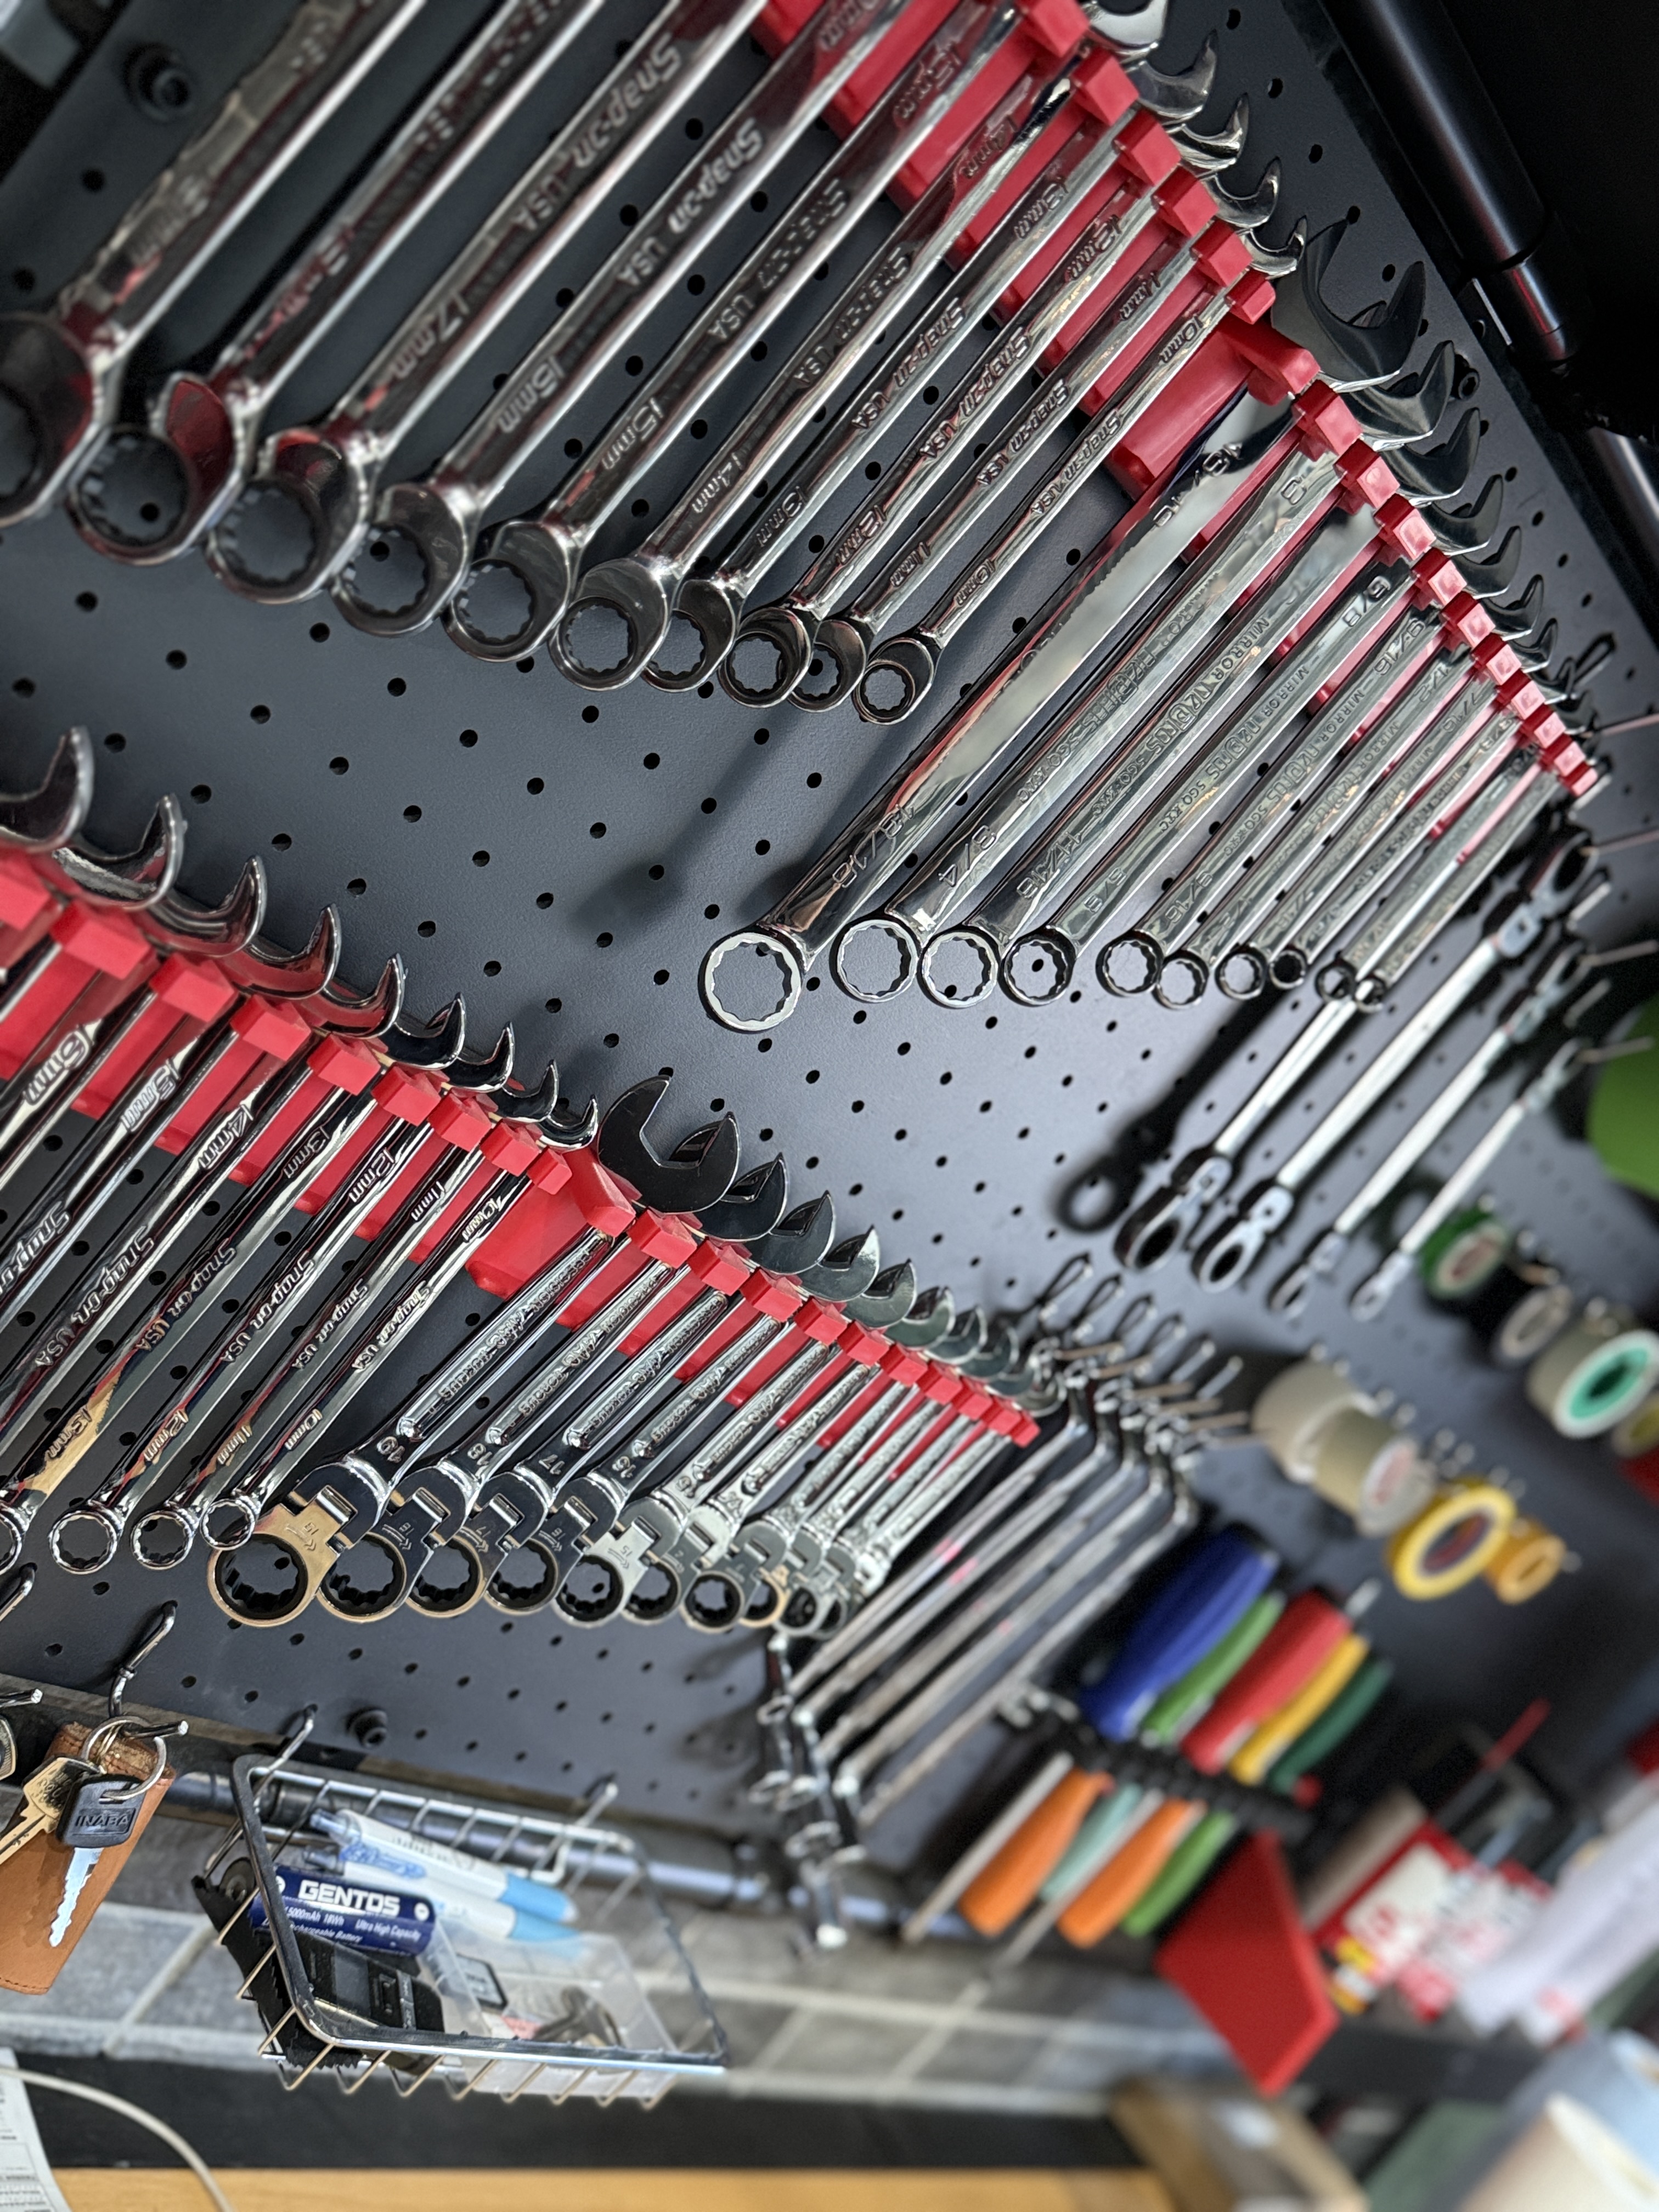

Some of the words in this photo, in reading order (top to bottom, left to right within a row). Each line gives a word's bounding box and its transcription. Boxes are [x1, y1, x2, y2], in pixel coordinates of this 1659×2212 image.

[560, 29, 691, 175] Snap-on
[508, 171, 570, 238] USA
[658, 113, 771, 240] Snap-on
[613, 233, 670, 292] USA
[383, 287, 475, 387] 17mm
[705, 290, 755, 345] USA
[885, 294, 971, 391] Snap-on
[1155, 313, 1205, 368] 10mm
[791, 343, 833, 388] USA
[948, 324, 1036, 422] Snap-on
[492, 353, 569, 439] 16mm
[849, 388, 891, 434] USA
[1001, 376, 1074, 458] Snap-on
[596, 395, 668, 476] 15mm
[917, 418, 959, 463] USA
[1055, 407, 1125, 486] Snap-on
[687, 451, 748, 518] 14mm
[974, 450, 1010, 489] USA
[752, 484, 811, 550] 13mm
[1030, 481, 1063, 517] USA
[830, 503, 889, 568] 12mm
[887, 540, 933, 591] 11mm
[951, 557, 998, 610] 10mm
[1339, 572, 1393, 631] 5/8
[1209, 614, 1270, 683] MIRROR
[1371, 616, 1426, 678] 9/16
[1259, 663, 1310, 720] MIRROR
[1316, 689, 1365, 744] MIRROR
[1440, 690, 1481, 736] 7/16
[1356, 720, 1400, 771] MIRROR
[1395, 744, 1434, 788] MIRROR
[830, 795, 917, 893] 13/16
[935, 821, 1000, 892] 3/4
[1013, 827, 1082, 904] 11/16
[1081, 864, 1128, 915] 5/8
[1162, 867, 1214, 925] 9/16
[16, 1023, 98, 1113] 16mm
[116, 1058, 187, 1136] 15mm
[193, 1102, 257, 1173] 14mm
[280, 1125, 332, 1182] 13mm
[344, 1147, 398, 1206] 12mm
[407, 1180, 447, 1223] 11mm
[458, 1196, 501, 1244] 10mm
[0, 1197, 76, 1304] Snap-o
[66, 1222, 157, 1329] Snap-on
[162, 1234, 240, 1322] Snap-on
[244, 1248, 319, 1332] Snap-on
[311, 1277, 371, 1344] Snap-on
[372, 1277, 435, 1347] Snap-on
[32, 1323, 76, 1371] USA
[134, 1316, 171, 1356] USA
[218, 1329, 253, 1367] USA
[291, 1342, 318, 1372] USA
[350, 1342, 377, 1372] USA
[43, 1405, 96, 1464] 13mm
[139, 1408, 190, 1464] 12mm
[214, 1424, 253, 1468] 11mm
[283, 1407, 324, 1453] 10mm
[373, 1432, 409, 1467] 19
[465, 1440, 495, 1469] 18
[538, 1449, 566, 1477] 17
[610, 1452, 639, 1482] 16
[474, 1523, 491, 1539] 17
[75, 1814, 128, 1827] INABA
[298, 1880, 400, 1917] GENTOS
[335, 1930, 363, 1943] Battery
[356, 1918, 374, 1932] Ultra
[375, 1922, 390, 1935] High
[391, 1925, 421, 1942] Capacity
